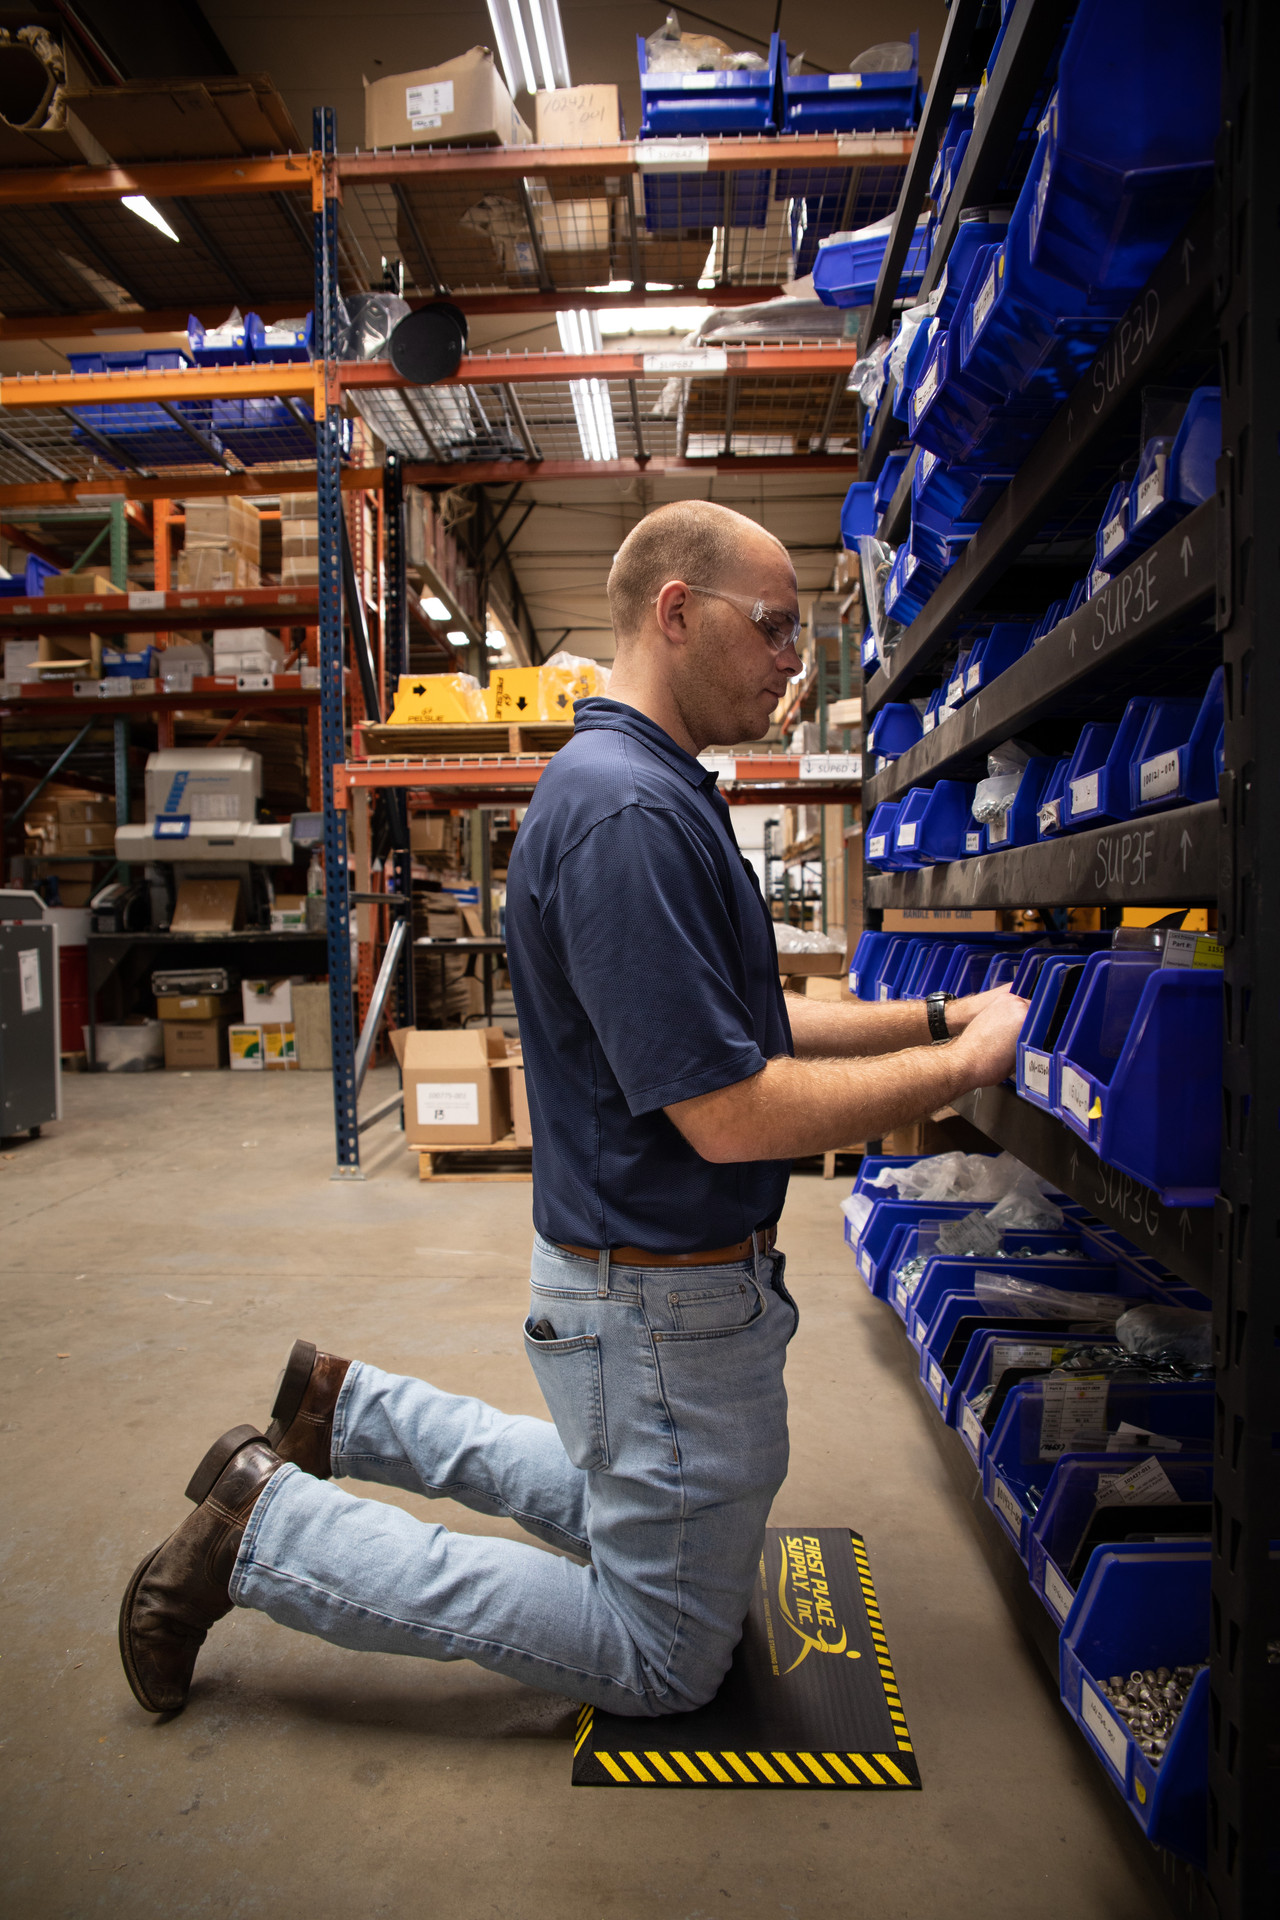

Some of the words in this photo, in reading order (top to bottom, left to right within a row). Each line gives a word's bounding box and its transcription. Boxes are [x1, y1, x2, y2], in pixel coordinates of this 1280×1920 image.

[1092, 289, 1160, 414] SUP3D
[1092, 551, 1159, 650] SUP3E
[818, 764, 848, 773] SUP6D
[1095, 830, 1155, 888] SUP3F
[903, 909, 929, 919] HANDLE
[933, 909, 952, 919] WITH
[786, 1535, 811, 1592] SUPPLY,
[802, 1535, 826, 1578] FIRST
[796, 1597, 814, 1625] Inc.
[810, 1578, 837, 1629] PLACE
[768, 1639, 778, 1665] STANDING
